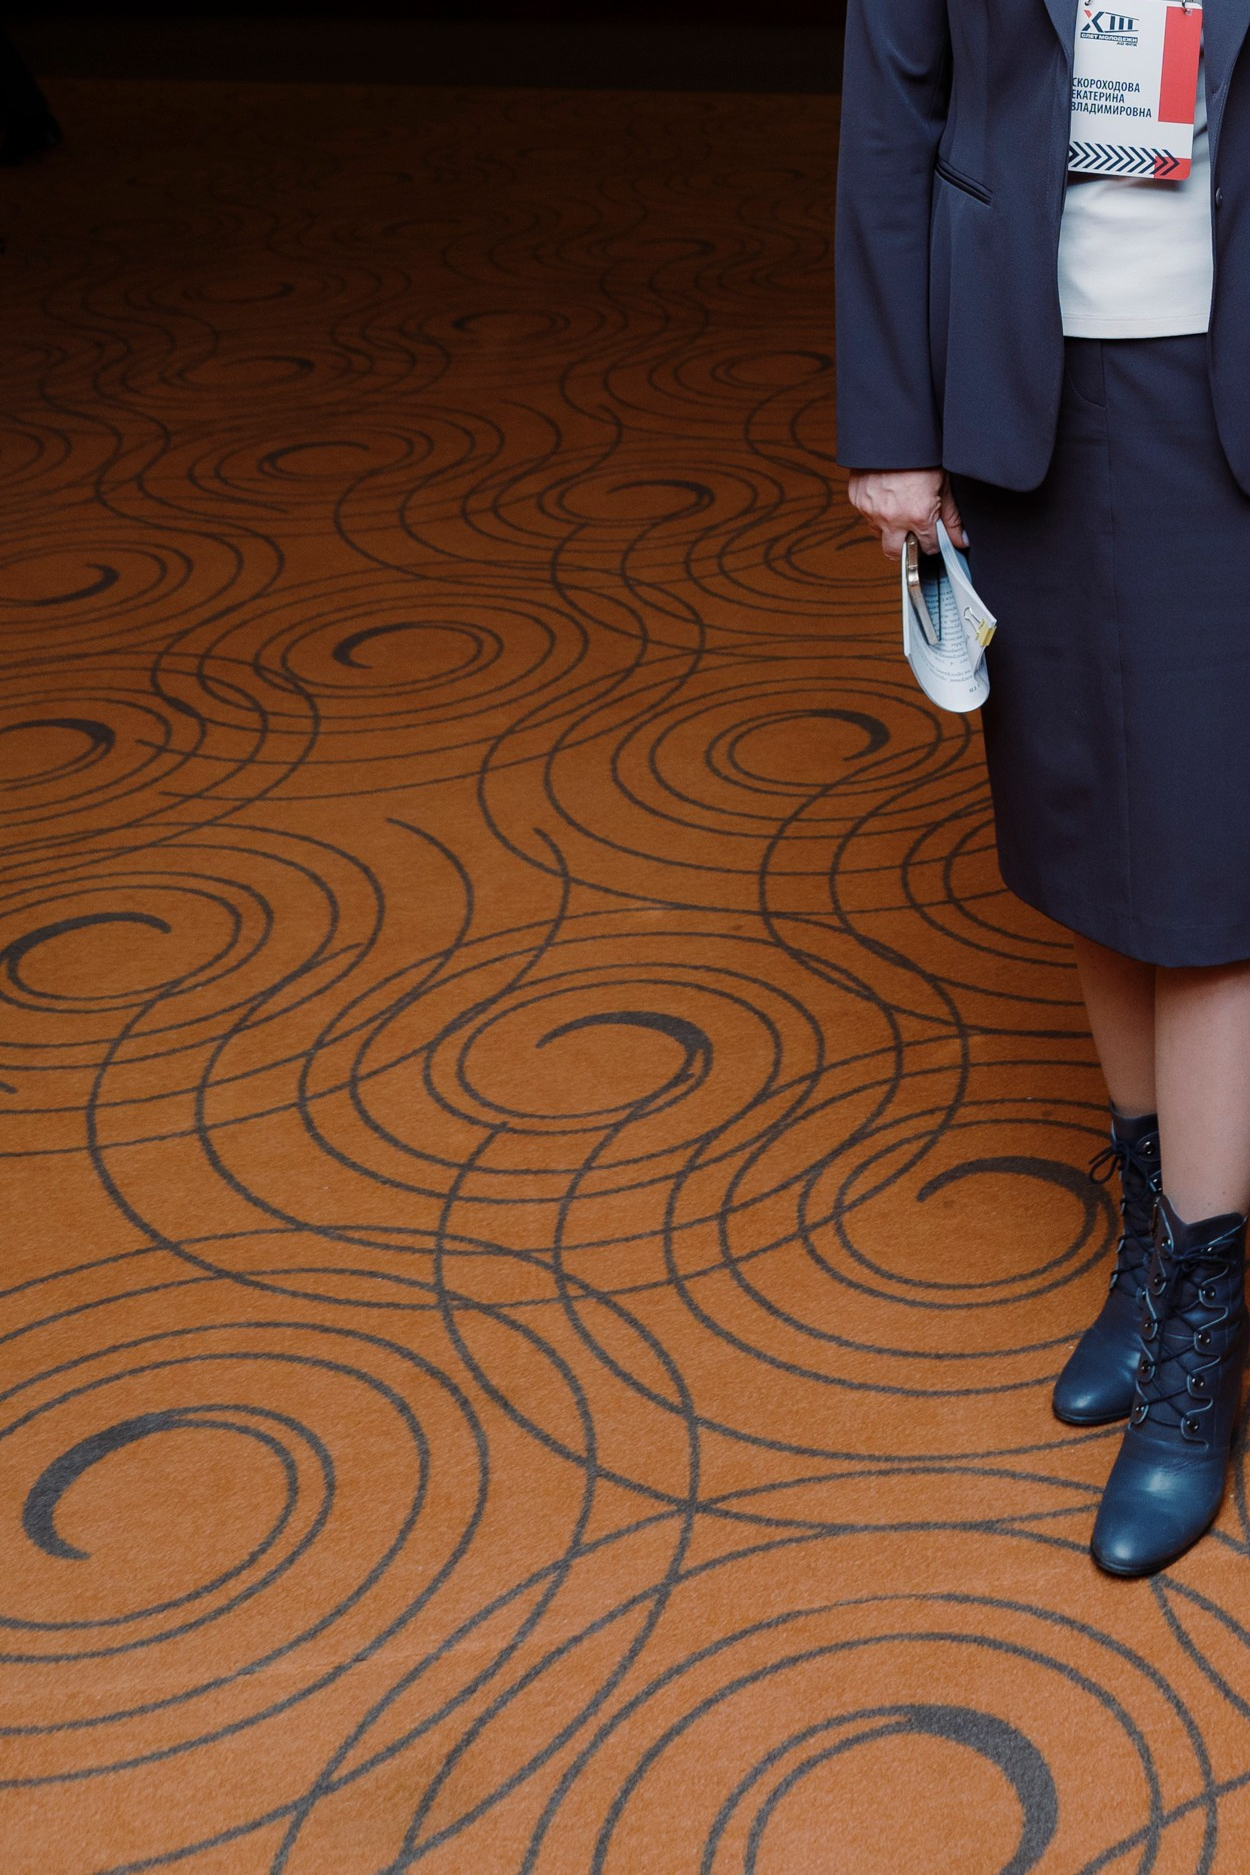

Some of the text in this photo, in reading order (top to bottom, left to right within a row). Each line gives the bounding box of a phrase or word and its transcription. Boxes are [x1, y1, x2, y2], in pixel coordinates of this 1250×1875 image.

[1072, 77, 1140, 93] СКОРОХОДОВА
[1072, 89, 1125, 103] ЕКАТЕРИНА
[1071, 101, 1152, 118] ВЛАДИМИРОВНА
